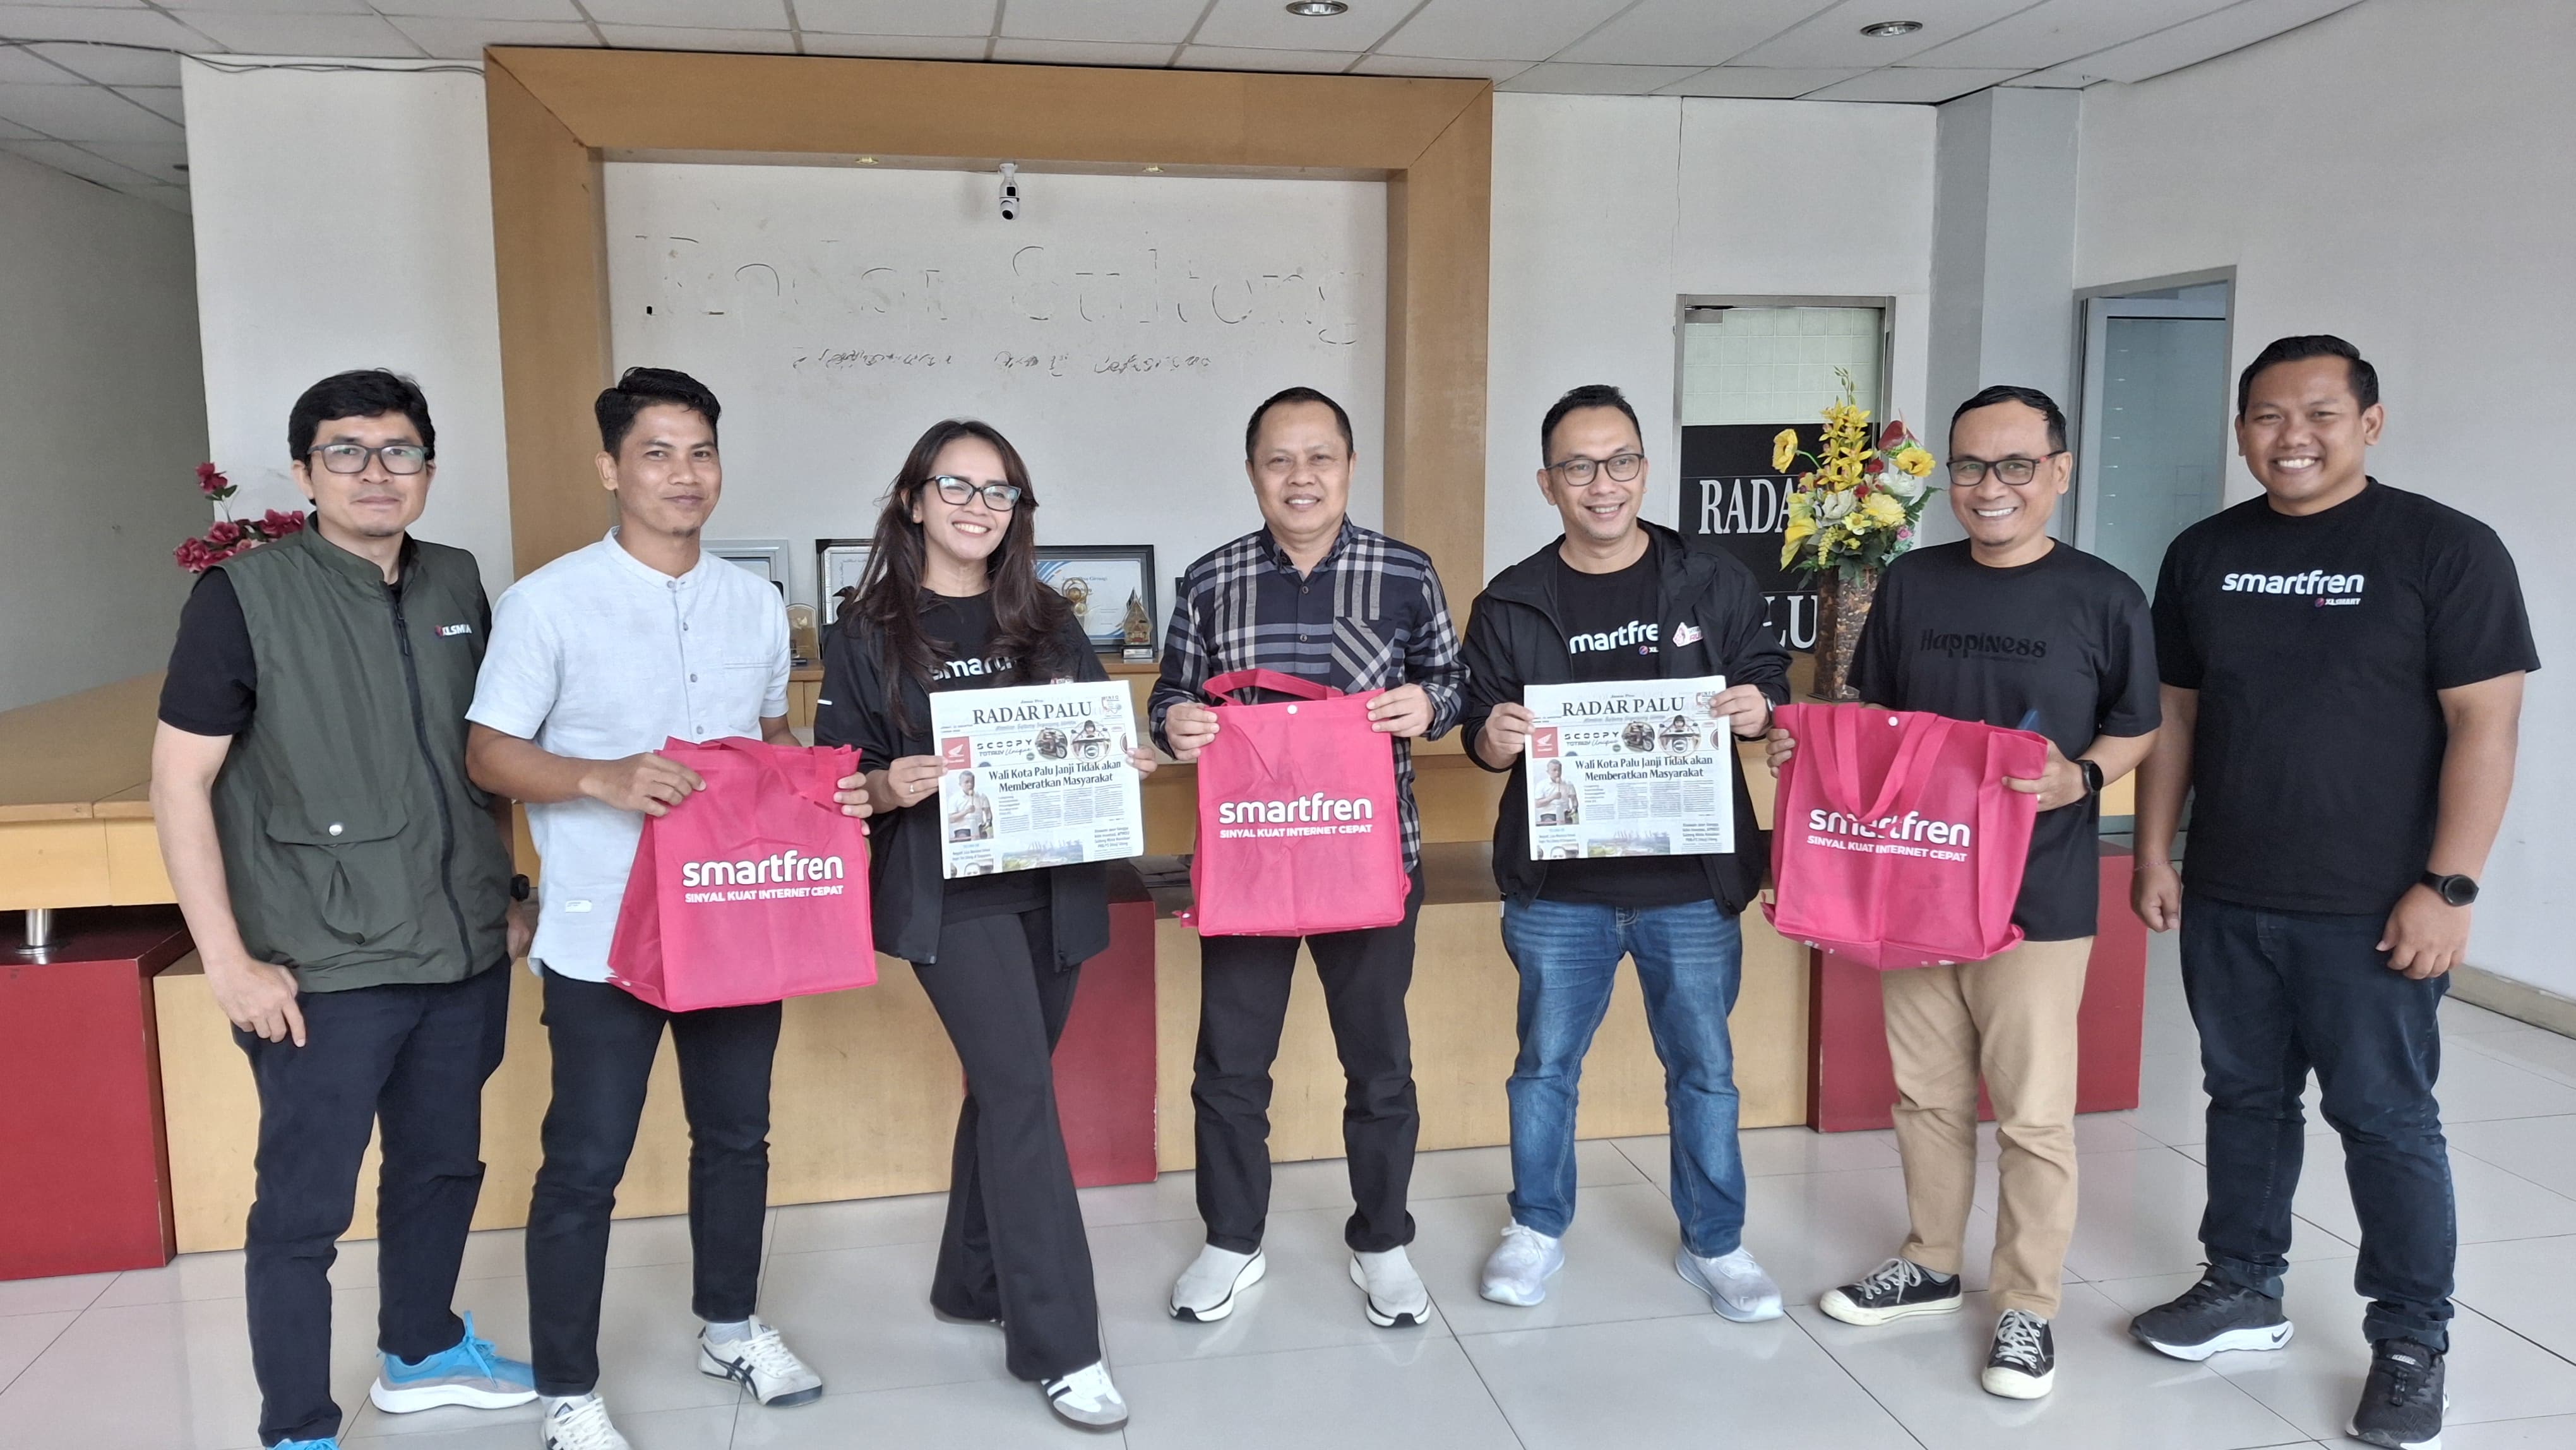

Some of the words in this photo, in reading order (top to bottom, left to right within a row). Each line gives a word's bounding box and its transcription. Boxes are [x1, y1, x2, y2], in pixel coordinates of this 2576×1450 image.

[1698, 478, 1823, 535] RADA
[2222, 570, 2364, 594] smartfren
[1569, 620, 1659, 654] martfre
[972, 705, 1041, 724] RADAR
[1043, 702, 1092, 719] PALU
[1562, 699, 1631, 717] RADAR
[1634, 697, 1685, 712] PALU
[977, 739, 1032, 750] SCOOPY
[1565, 731, 1619, 740] SCOOPY
[989, 769, 1009, 781] Wali
[1011, 769, 1032, 779] Kota
[1034, 766, 1053, 776] Palu
[1055, 764, 1074, 777] Janji
[1076, 762, 1100, 772] Tidak
[1102, 760, 1121, 770] akan
[1575, 760, 1595, 769] Wali
[1597, 759, 1618, 769] Kota
[1620, 758, 1640, 767] Palu
[1642, 757, 1662, 769] Janji
[1664, 756, 1688, 765] Tidak
[1690, 755, 1713, 765] akan
[999, 778, 1061, 793] Memberatkan
[1063, 772, 1112, 787] Masyarakat
[1585, 770, 1647, 781] Memberatkan
[1650, 768, 1703, 781] Masyarakat
[1219, 792, 1373, 824] smartfren
[1220, 828, 1256, 839] SINYAL
[1257, 827, 1285, 837] KUAT
[1287, 825, 1336, 837] INTERNET
[1339, 824, 1373, 834] CEPAT
[1807, 835, 1846, 850] SINYAL
[1848, 842, 1874, 853] KUAT
[1876, 844, 1929, 858] INTERNET
[1929, 850, 1967, 862] CEPAT
[682, 849, 844, 887] smartfren
[685, 891, 725, 903] SINYAL
[727, 890, 756, 901] KUAT
[758, 888, 809, 899] INTERNET
[811, 885, 844, 897] CEPAT
